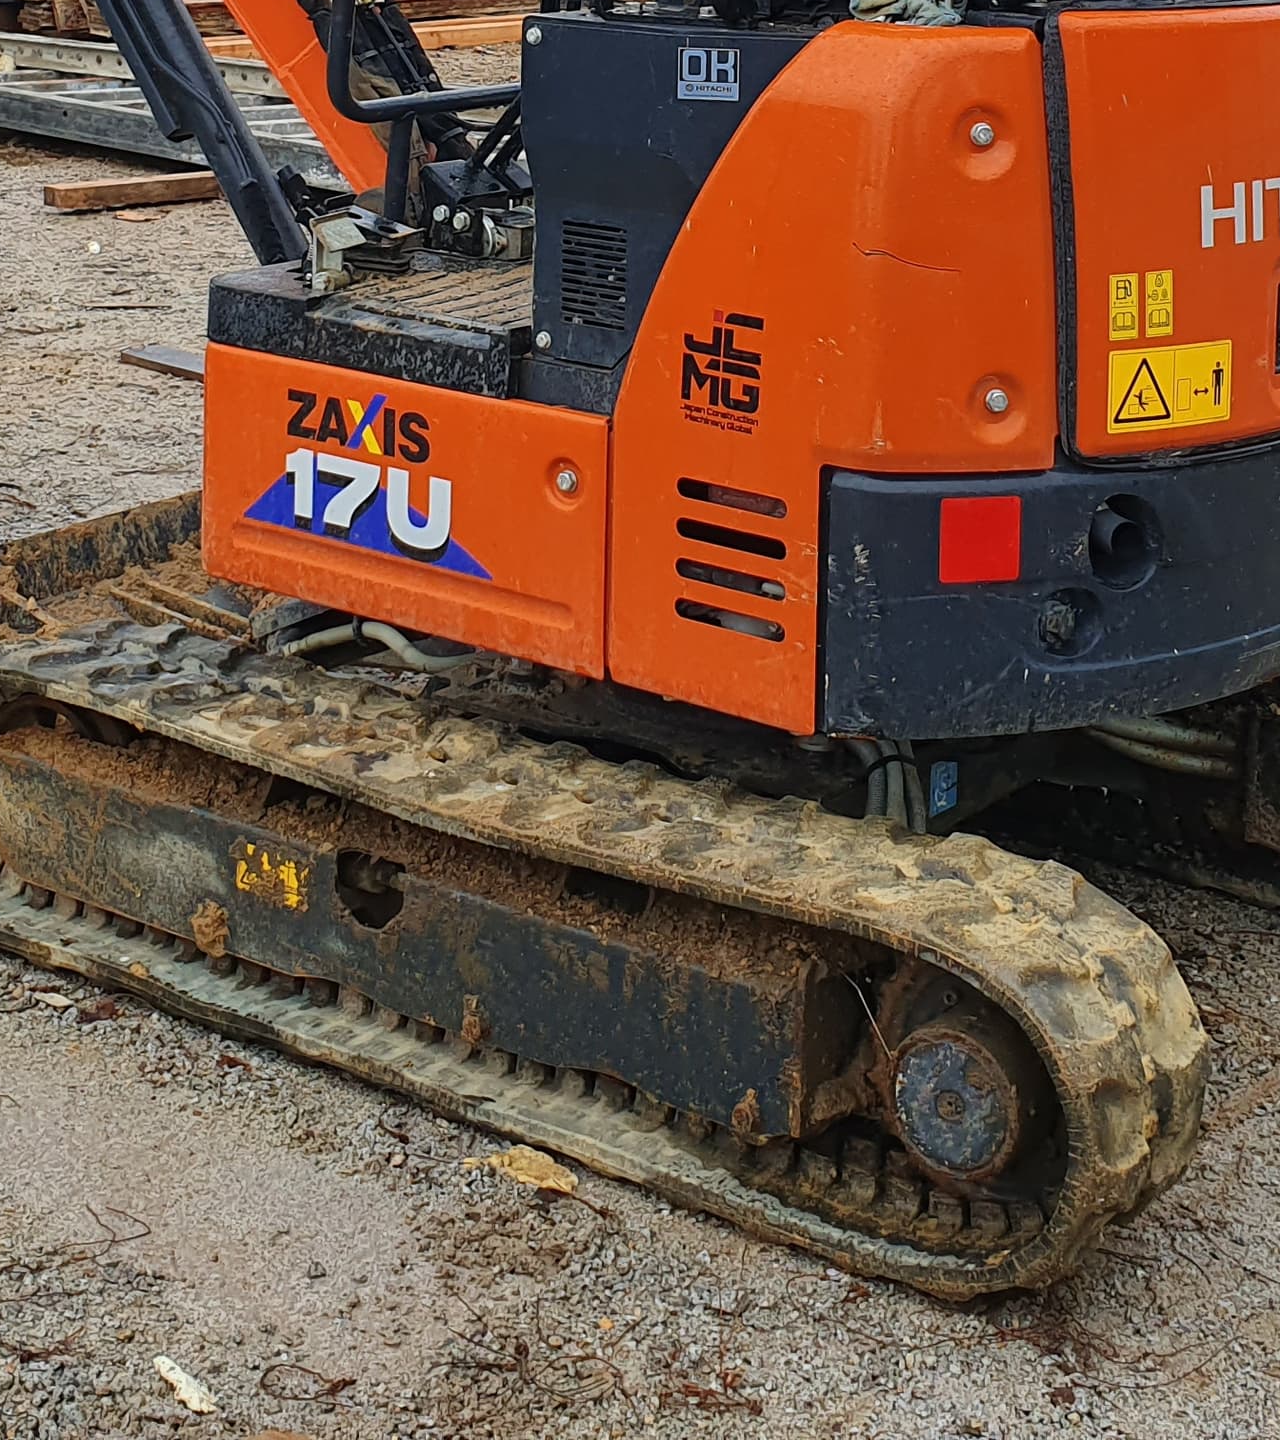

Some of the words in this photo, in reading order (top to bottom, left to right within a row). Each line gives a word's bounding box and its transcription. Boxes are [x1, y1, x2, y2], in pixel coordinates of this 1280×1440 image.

[682, 49, 735, 83] OK
[695, 85, 732, 93] HITACHI
[286, 388, 431, 463] ZAXIS
[286, 448, 452, 558] 17U
